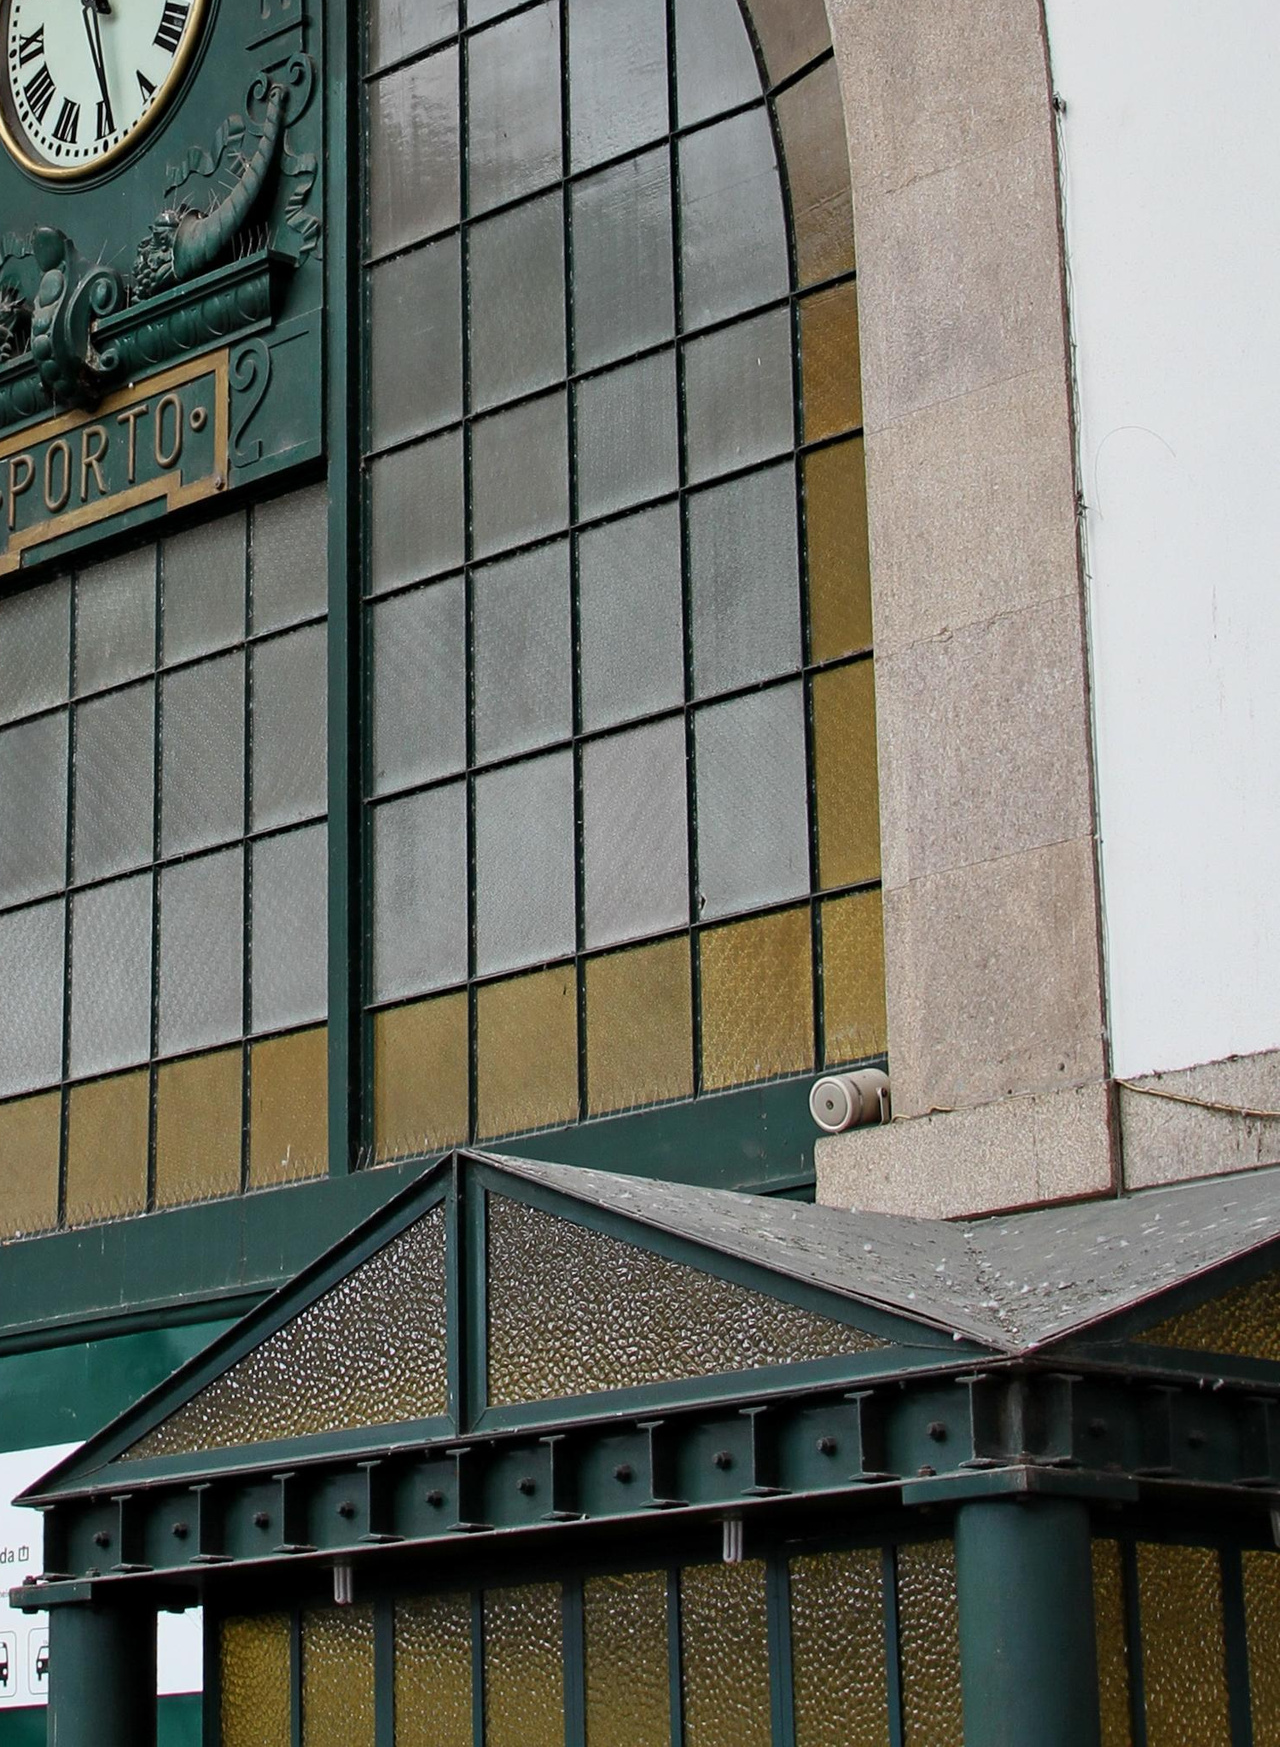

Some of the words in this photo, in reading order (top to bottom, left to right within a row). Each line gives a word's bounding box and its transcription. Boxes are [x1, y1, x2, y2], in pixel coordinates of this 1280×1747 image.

[20, 22, 45, 69] IX
[152, 0, 190, 57] IIII
[23, 61, 56, 125] VIII
[51, 96, 81, 144] VII
[7, 393, 183, 532] PORTO
